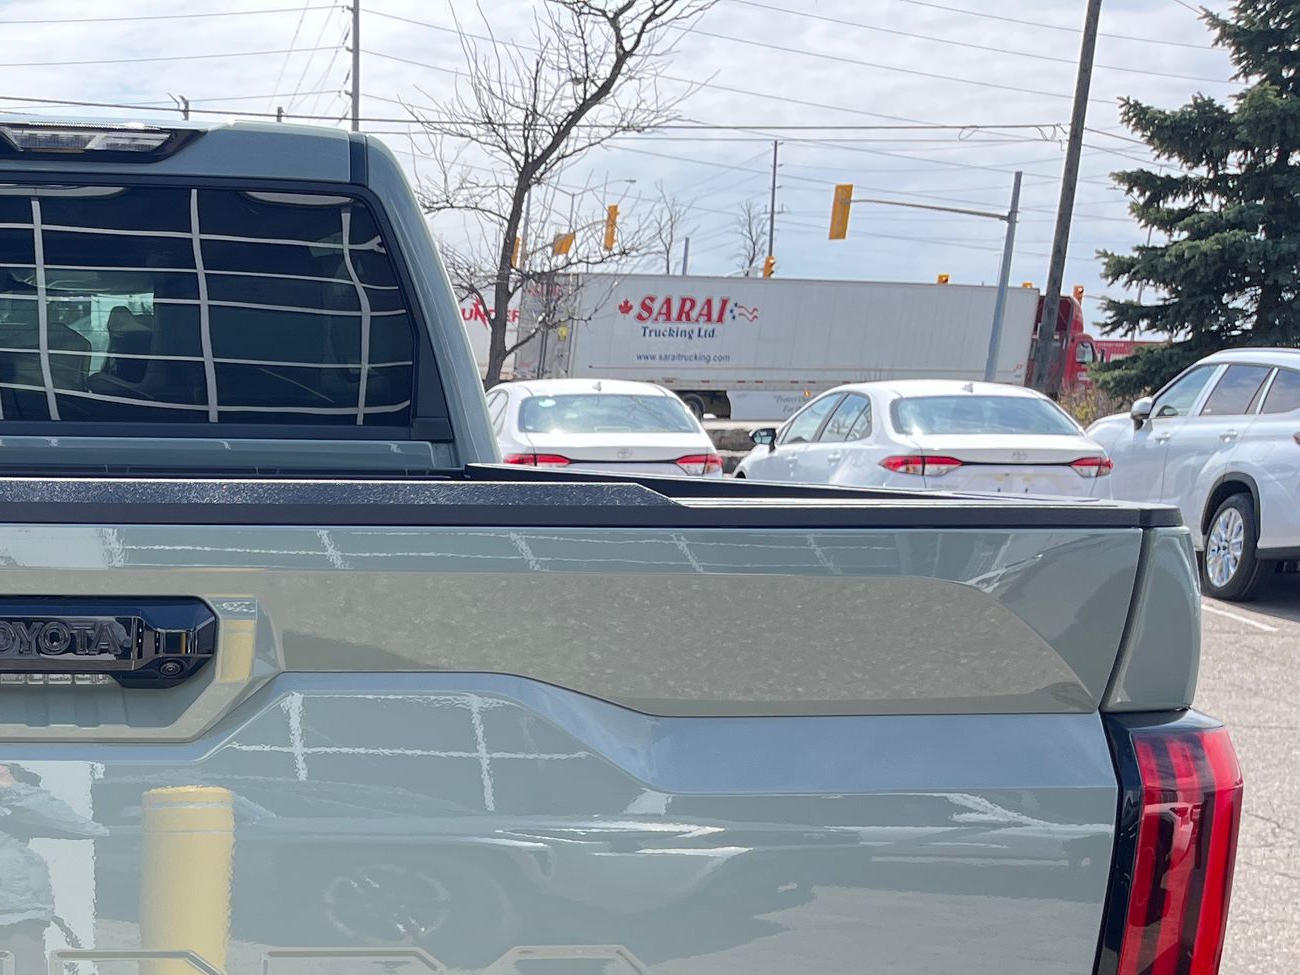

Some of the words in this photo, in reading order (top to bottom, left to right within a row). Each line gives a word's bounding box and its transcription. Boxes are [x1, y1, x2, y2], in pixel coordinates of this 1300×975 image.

[635, 295, 730, 324] SARAI
[641, 326, 694, 340] Trucking
[697, 327, 718, 339] Ltd.
[636, 353, 730, 364] www.saraitrucking.com
